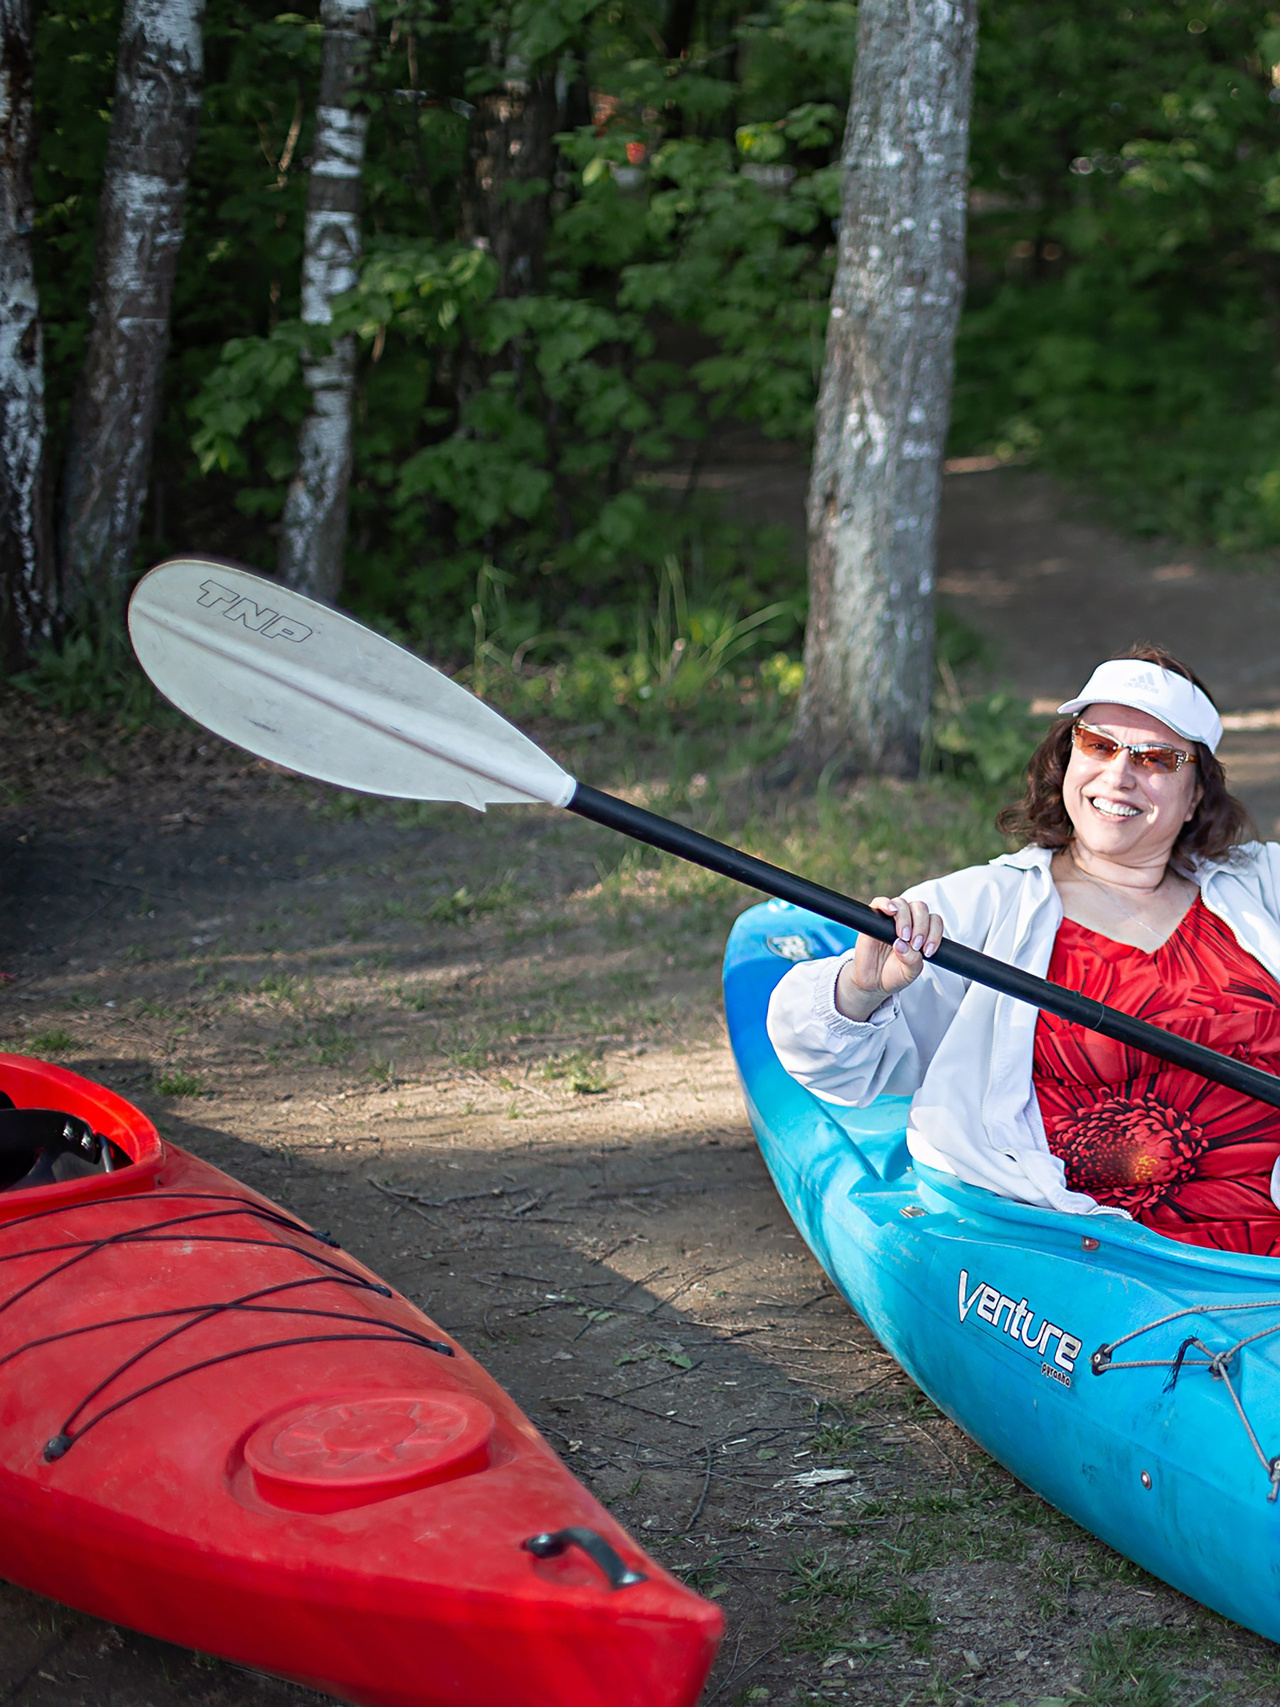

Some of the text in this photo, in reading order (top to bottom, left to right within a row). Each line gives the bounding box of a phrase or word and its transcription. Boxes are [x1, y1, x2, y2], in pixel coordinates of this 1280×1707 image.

[196, 579, 314, 643] TNP
[958, 1268, 1083, 1374] Venture
[1041, 1362, 1071, 1388] pyranha
